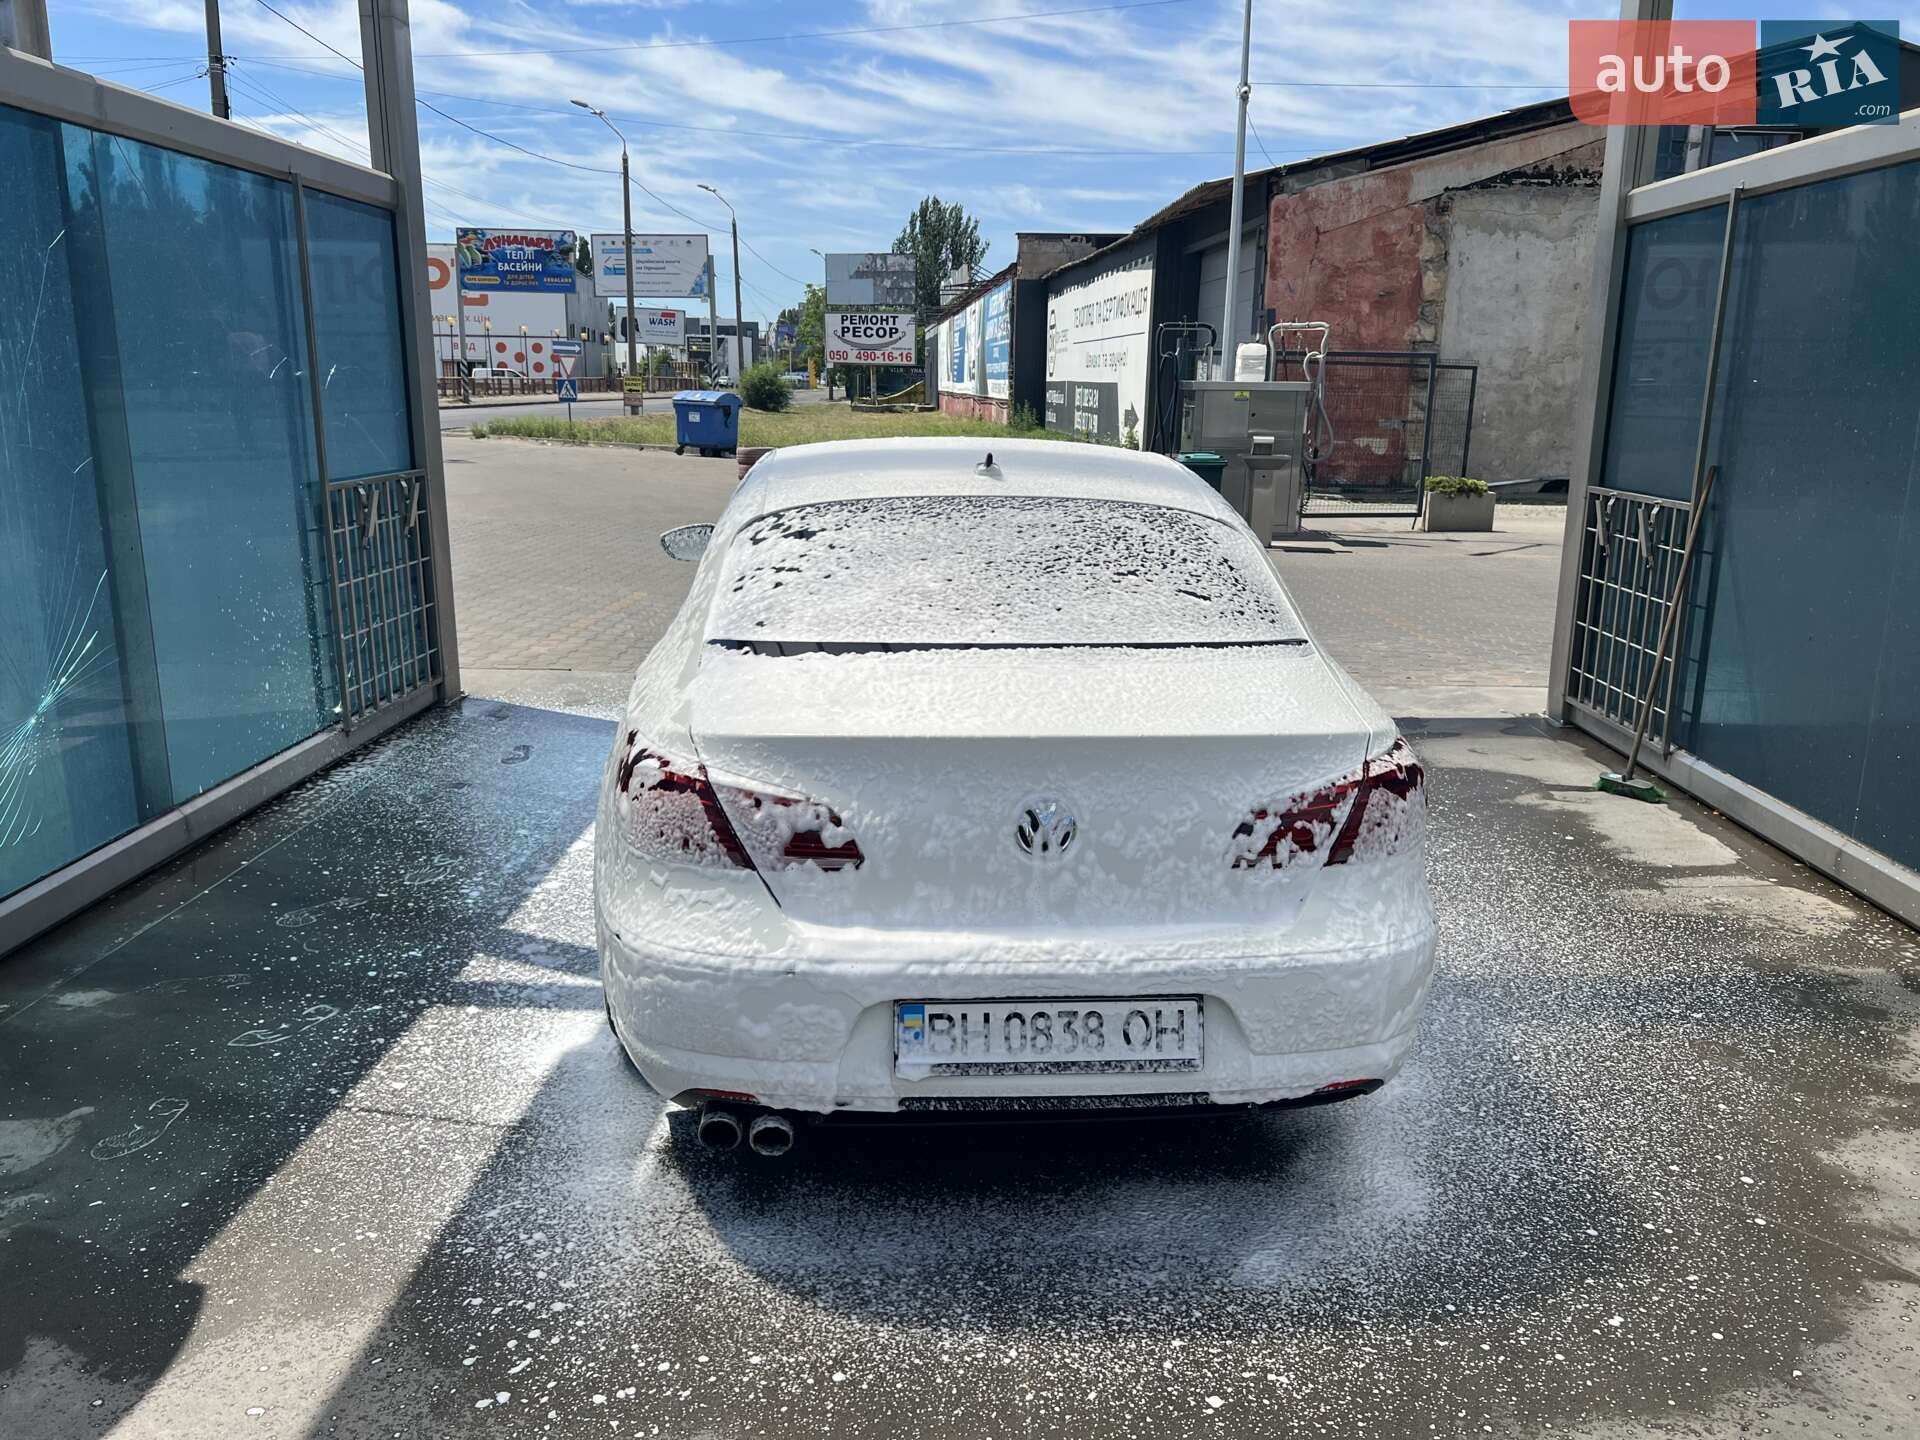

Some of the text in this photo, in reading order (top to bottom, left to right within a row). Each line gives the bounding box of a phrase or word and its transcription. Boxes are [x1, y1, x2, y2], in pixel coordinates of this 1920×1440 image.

[482, 235, 554, 251] ЛУНАПАРК
[505, 250, 535, 260] ТЕПЛІ
[497, 261, 542, 272] БАСЕЙНИ
[649, 317, 676, 327] WASH
[840, 314, 899, 326] РЕМОНТ
[841, 326, 899, 338] РЕСОР
[829, 350, 913, 363] 050 490-16-16
[1003, 1010, 1106, 1054] 0838
[1122, 1008, 1185, 1052] OH
